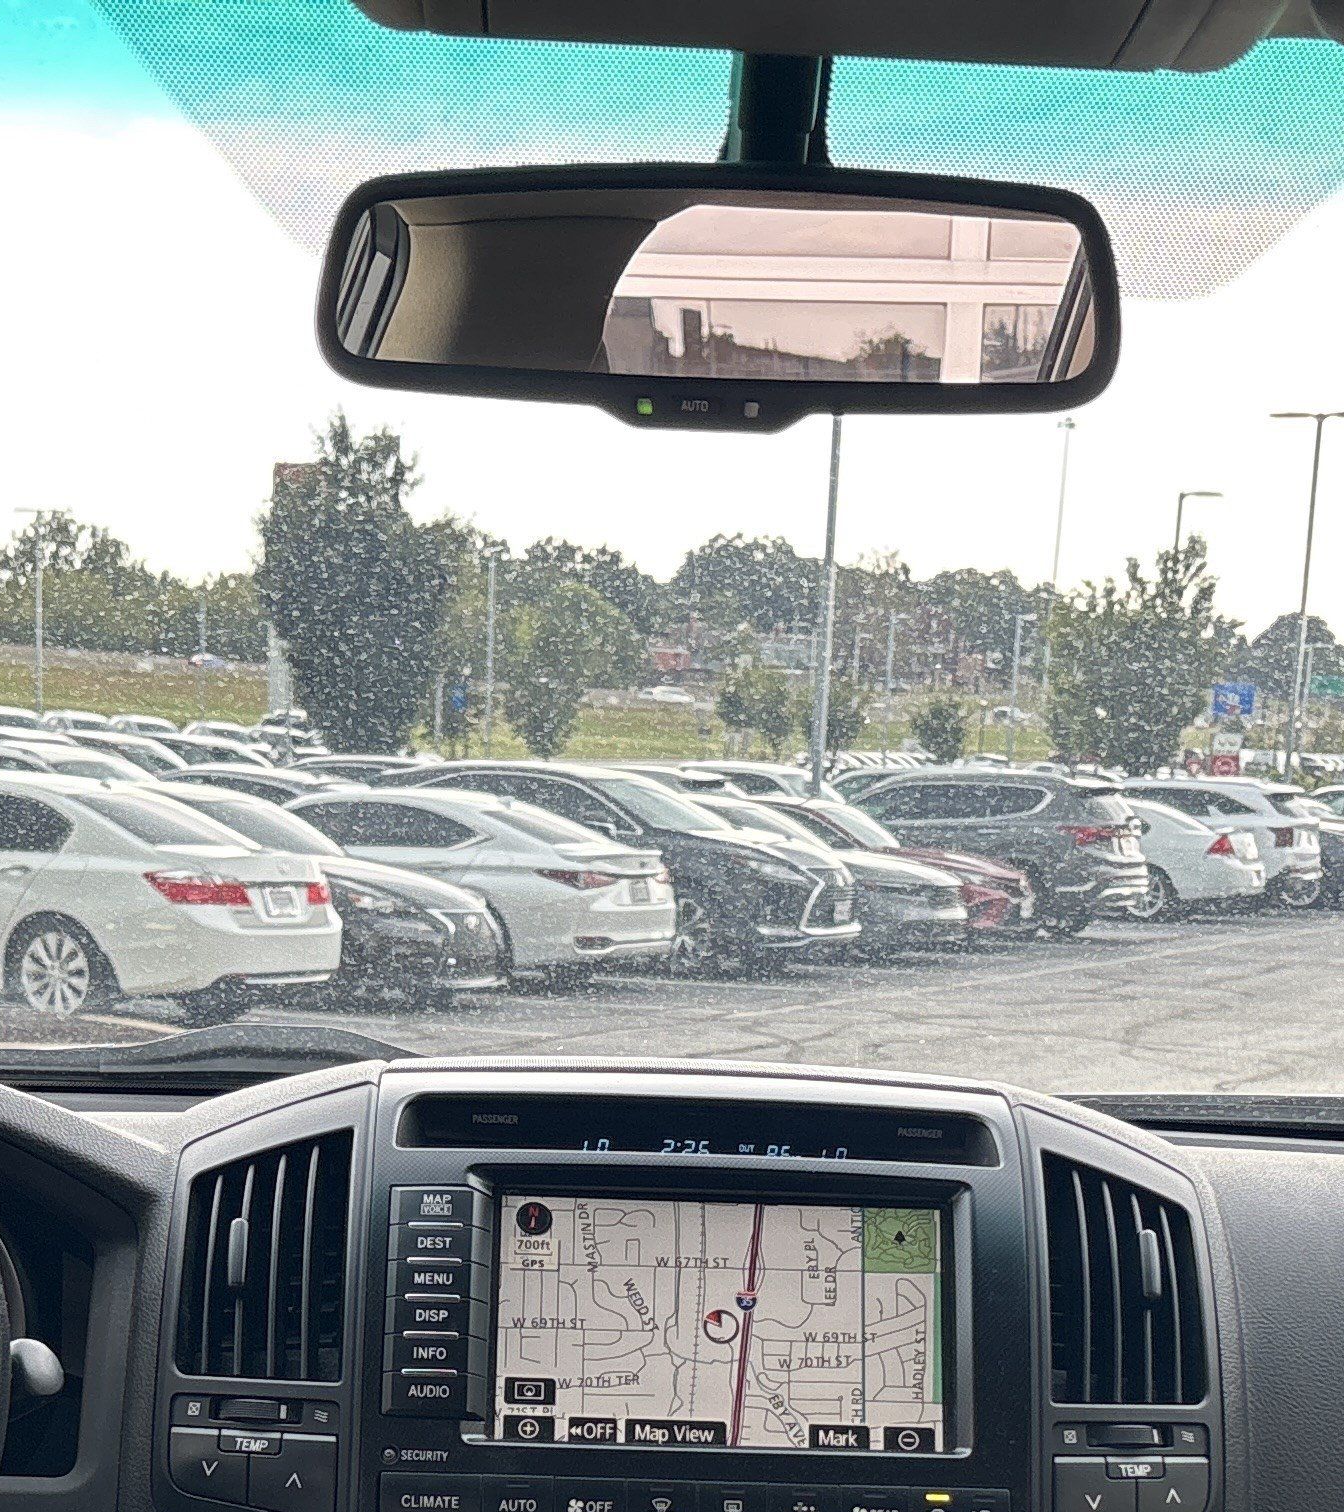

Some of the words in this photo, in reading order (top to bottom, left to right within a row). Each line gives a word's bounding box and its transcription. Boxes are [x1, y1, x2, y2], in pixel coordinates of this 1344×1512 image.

[681, 400, 709, 412] AUTO
[472, 1114, 519, 1125] PASSENGER
[897, 1127, 943, 1139] PASSENGER
[422, 1193, 452, 1204] MAP
[422, 1204, 452, 1214] VOICE
[577, 1202, 590, 1220] DR
[416, 1236, 453, 1249] DEST
[516, 1238, 551, 1251] 700ft
[521, 1258, 545, 1268] GPS
[655, 1256, 670, 1268] W
[712, 1257, 730, 1268] ST
[413, 1272, 453, 1285] MENU
[415, 1309, 449, 1322] DISP
[511, 1317, 526, 1328] W
[569, 1318, 587, 1329] ST
[803, 1331, 818, 1342] W
[822, 1331, 857, 1342] 69TH
[914, 1328, 926, 1344] ST
[412, 1346, 447, 1360] INFO
[777, 1357, 792, 1369] W
[798, 1356, 832, 1368] 70TH
[835, 1355, 852, 1367] ST
[911, 1348, 926, 1400] HADLEY
[557, 1377, 572, 1389] W
[616, 1375, 640, 1386] TER
[407, 1385, 450, 1398] AUDIO
[851, 1387, 862, 1405] RD
[583, 1422, 615, 1440] OFF
[634, 1423, 669, 1445] Map
[673, 1424, 715, 1443] View
[234, 1437, 269, 1451] TEMP
[818, 1429, 858, 1447] Mark
[400, 1449, 449, 1462] SECURITY
[1117, 1464, 1152, 1477] TEMP
[401, 1494, 460, 1510] CLIMATE
[498, 1499, 537, 1512] AUTO
